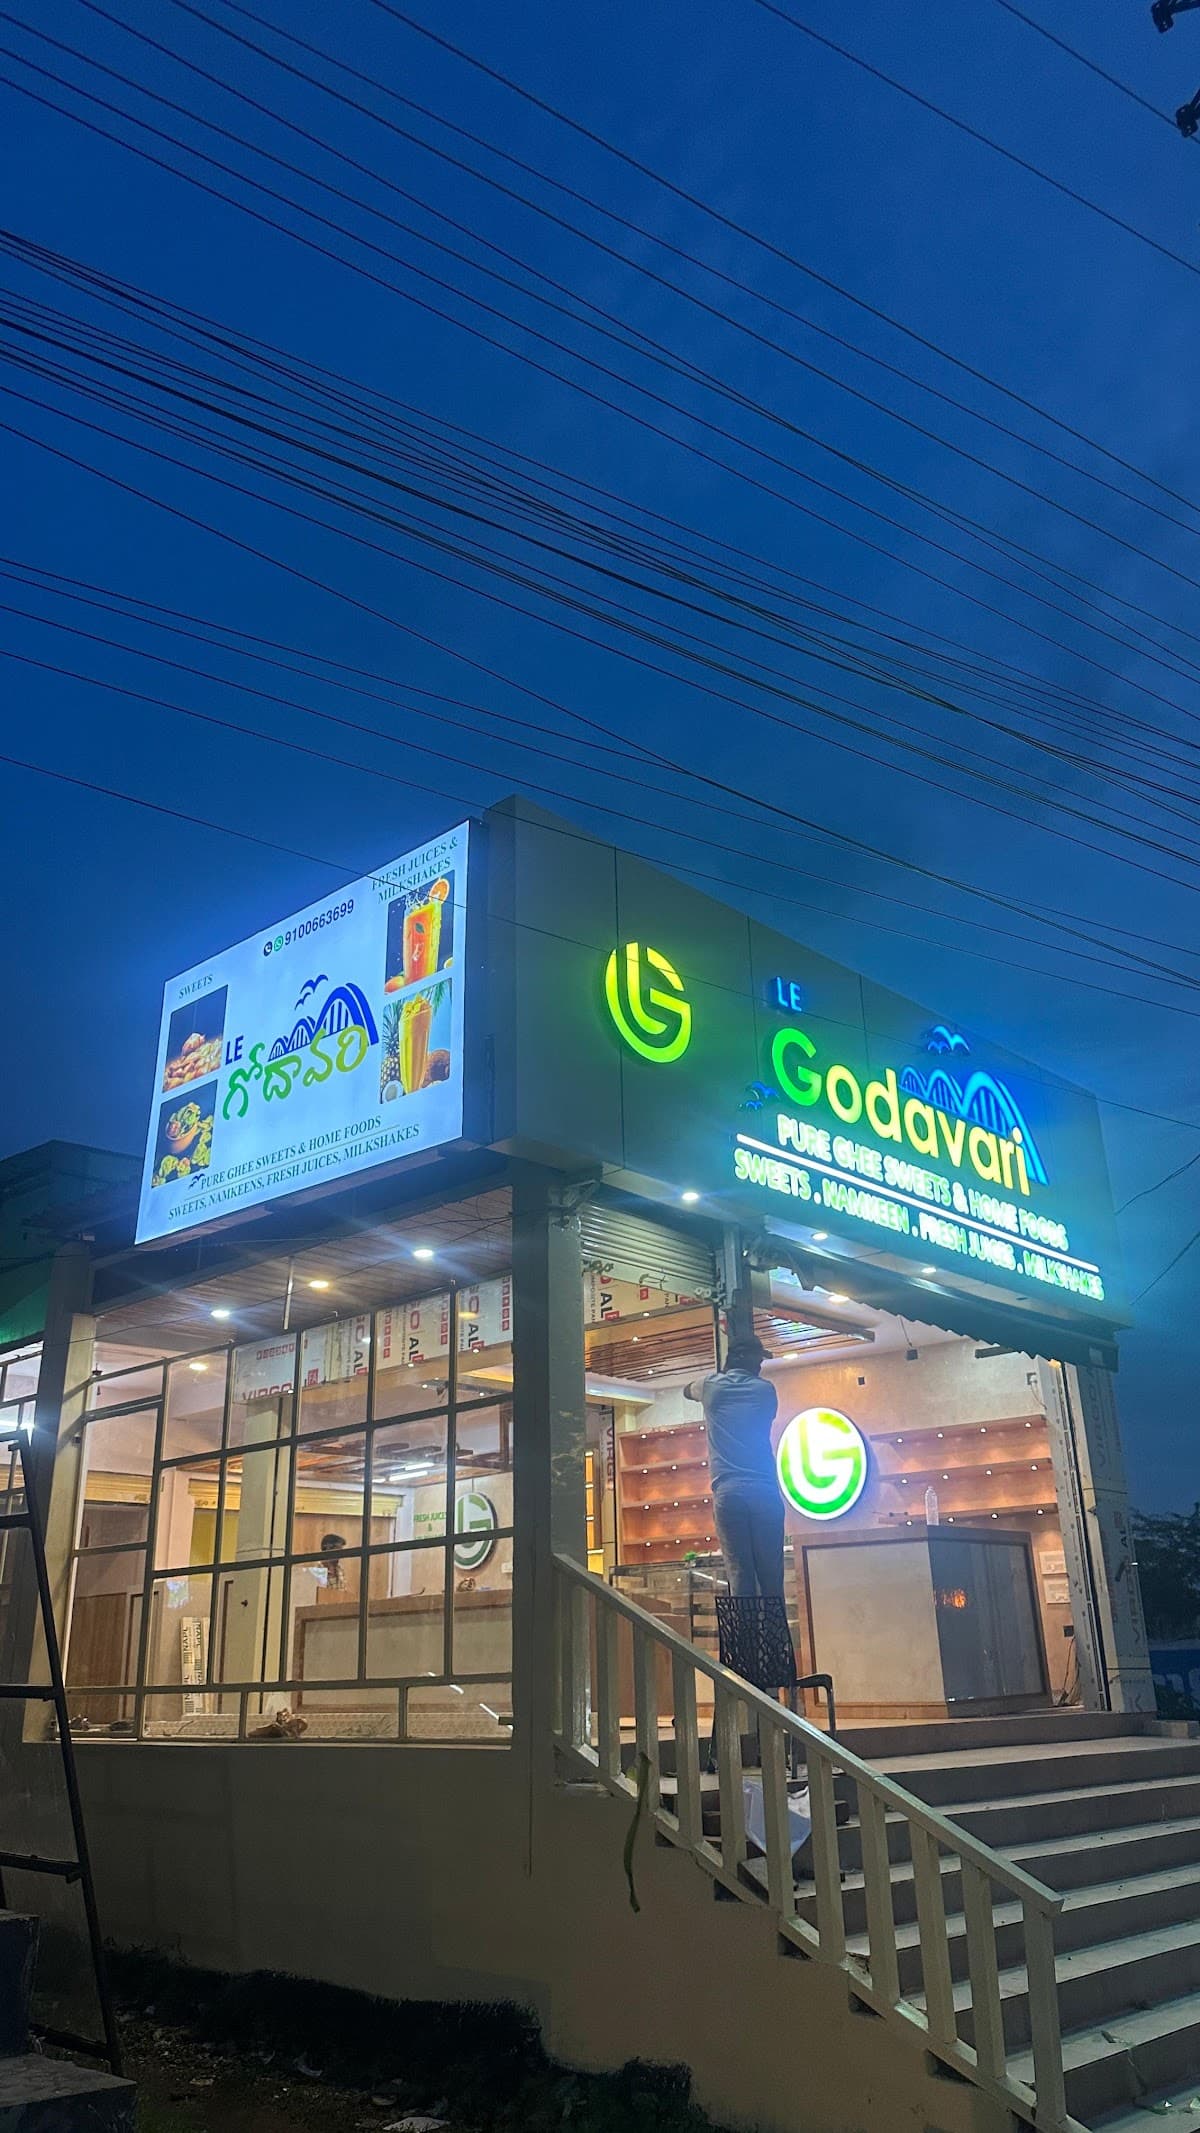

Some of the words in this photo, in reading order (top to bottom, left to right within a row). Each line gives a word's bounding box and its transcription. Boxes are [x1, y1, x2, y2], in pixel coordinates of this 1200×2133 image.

[372, 864, 406, 891] FRESH
[408, 842, 447, 872] JUICES
[449, 836, 459, 850] &
[378, 857, 451, 903] MILKSHAKES
[284, 899, 354, 946] 9100663699
[179, 973, 214, 999] SWEETS
[775, 976, 803, 1012] LE
[222, 1025, 369, 1121] గోదావరి
[225, 1035, 244, 1065] LE
[771, 1027, 1031, 1197] Godavari
[168, 1197, 207, 1220] SWEETS,
[208, 1180, 265, 1206] NAMKEENS,
[266, 1163, 300, 1186] FRESH
[301, 1151, 342, 1174] JUICES,
[343, 1123, 420, 1160] MILKSHAKES
[200, 1170, 225, 1190] PURE
[227, 1160, 255, 1180] GHEE
[256, 1145, 296, 1170] SWEETS
[298, 1142, 306, 1154] &
[309, 1129, 342, 1151] HOME
[344, 1115, 381, 1139] FOODS
[776, 1113, 833, 1163] PURE
[832, 1135, 884, 1183] GHEE
[883, 1155, 952, 1207] SWEETS
[952, 1181, 970, 1215] &
[968, 1188, 1019, 1234] HOME
[1018, 1207, 1069, 1252] FOODS
[918, 1211, 968, 1255] FRESH
[968, 1230, 1017, 1271] JUICES
[1022, 1250, 1105, 1301] MILKSHAKES
